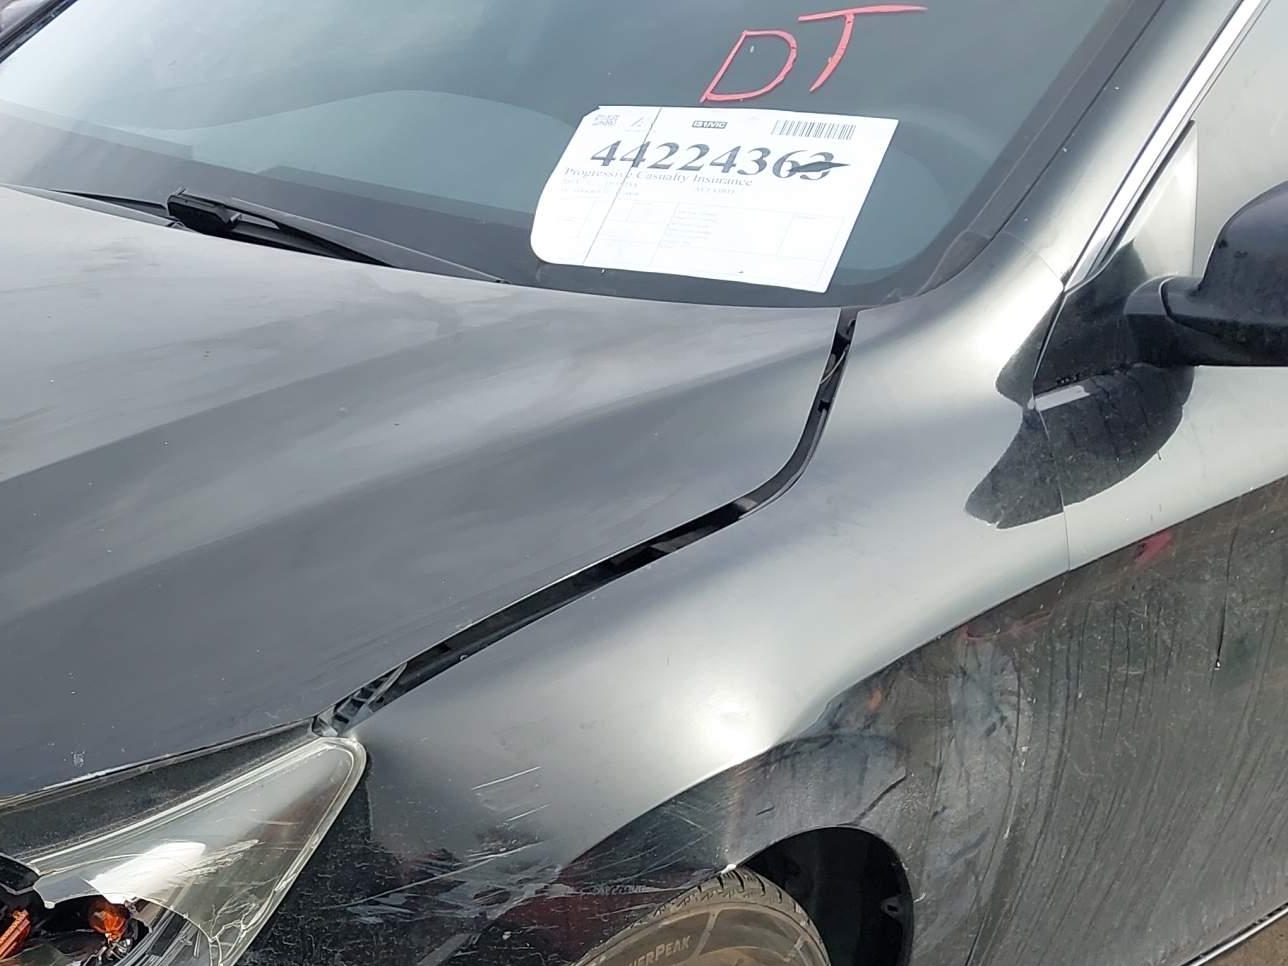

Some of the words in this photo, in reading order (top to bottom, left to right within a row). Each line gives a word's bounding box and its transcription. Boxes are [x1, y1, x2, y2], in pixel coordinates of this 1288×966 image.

[700, 4, 928, 102] DT
[590, 140, 834, 181] 44224363
[636, 170, 689, 184] Casualty
[692, 173, 753, 187] Insurance
